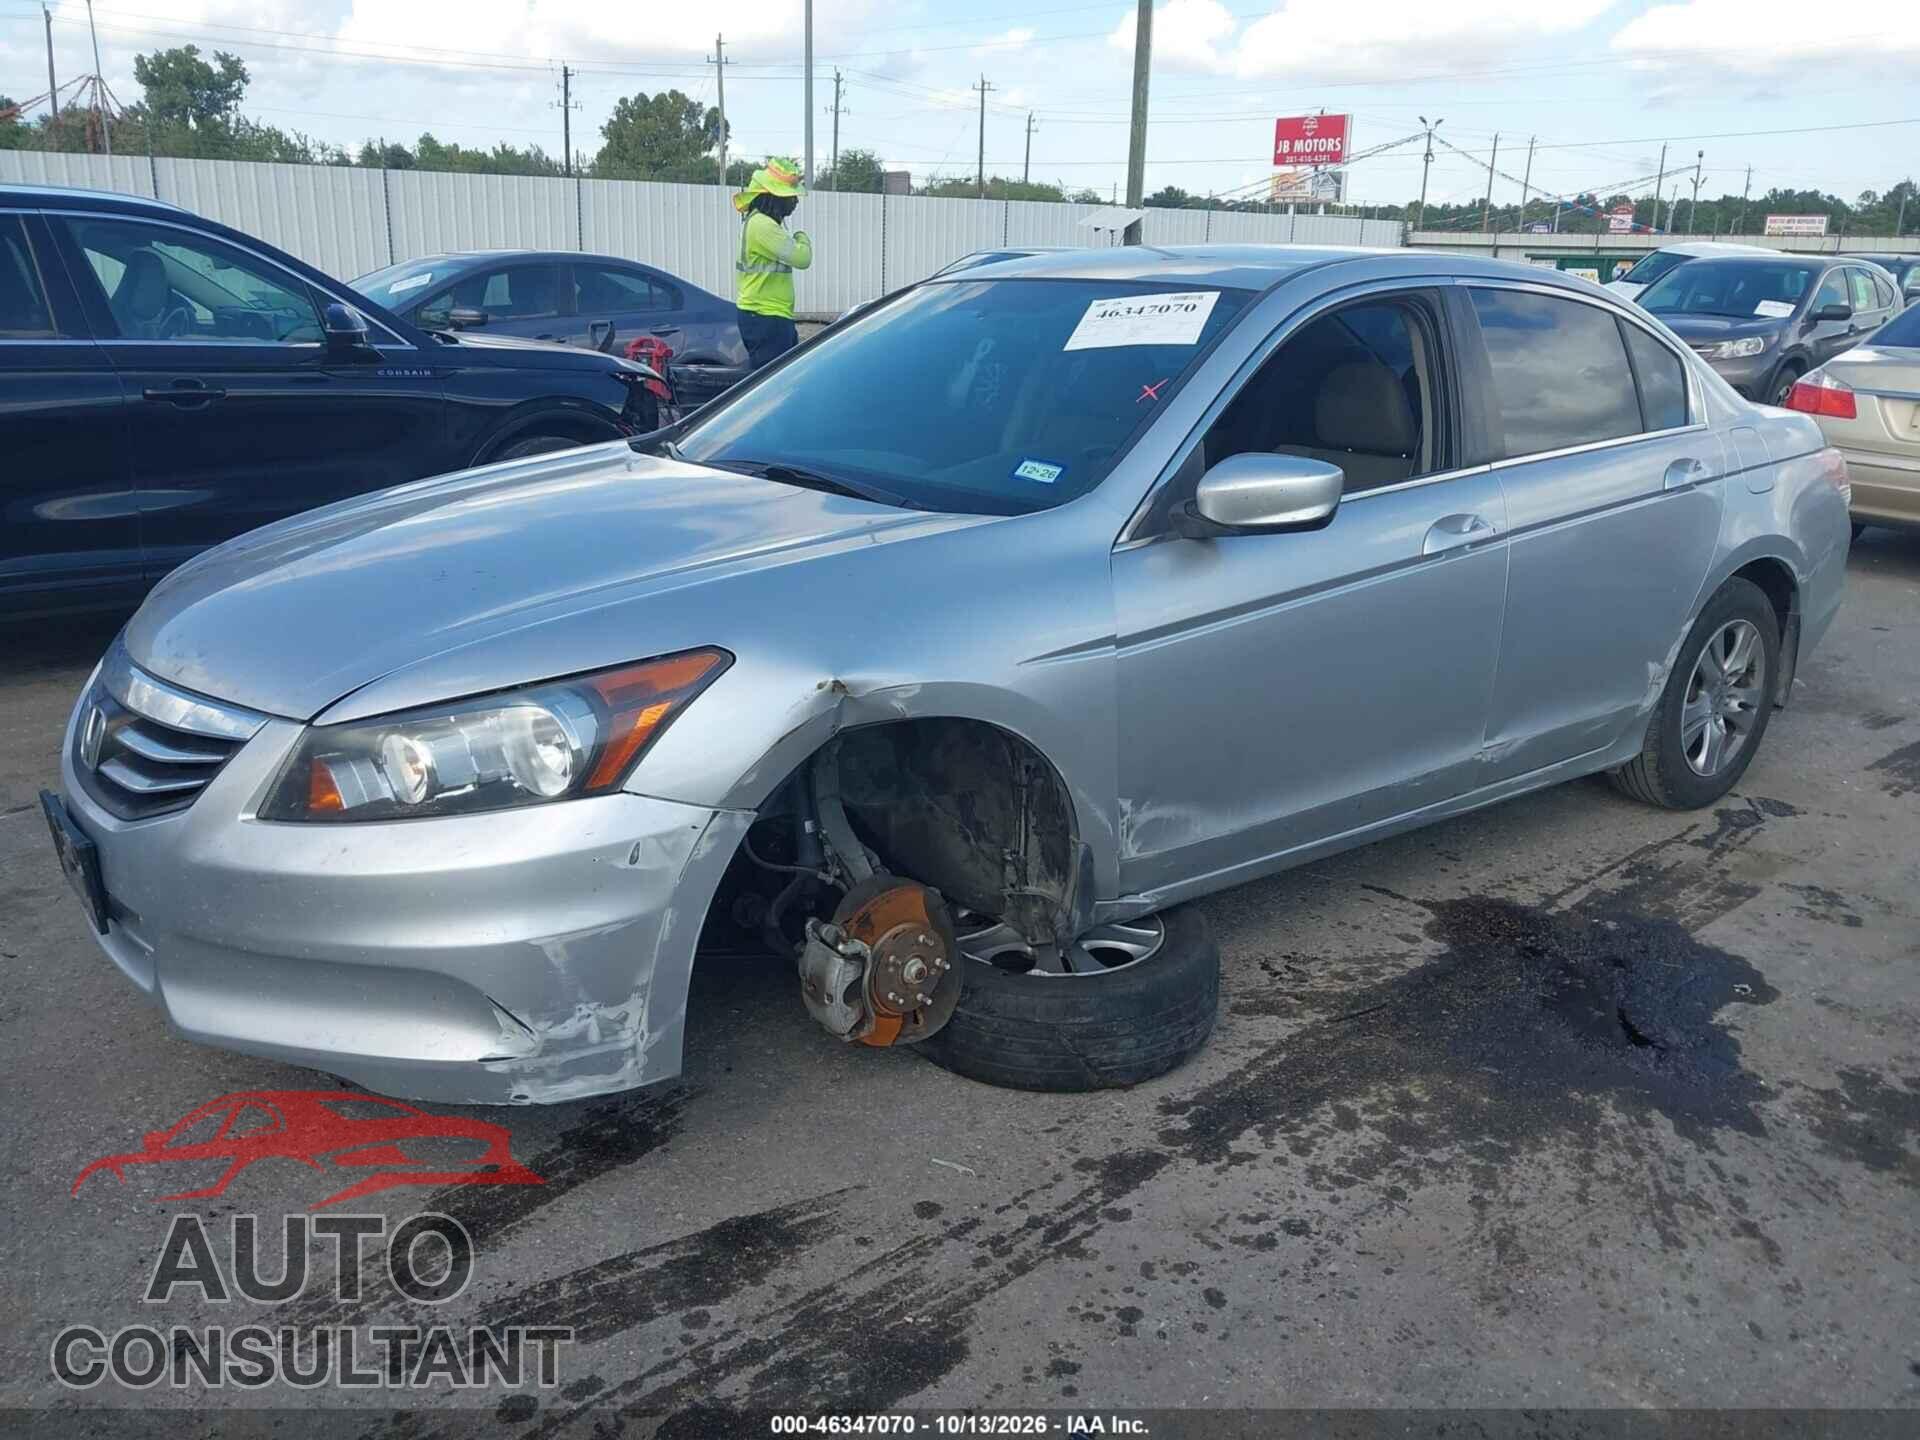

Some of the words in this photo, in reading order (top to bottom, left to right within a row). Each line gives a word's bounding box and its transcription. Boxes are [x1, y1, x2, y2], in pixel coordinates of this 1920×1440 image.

[1277, 139, 1290, 154] JB
[1294, 137, 1342, 153] MOTORS
[1096, 303, 1197, 319] 46347070
